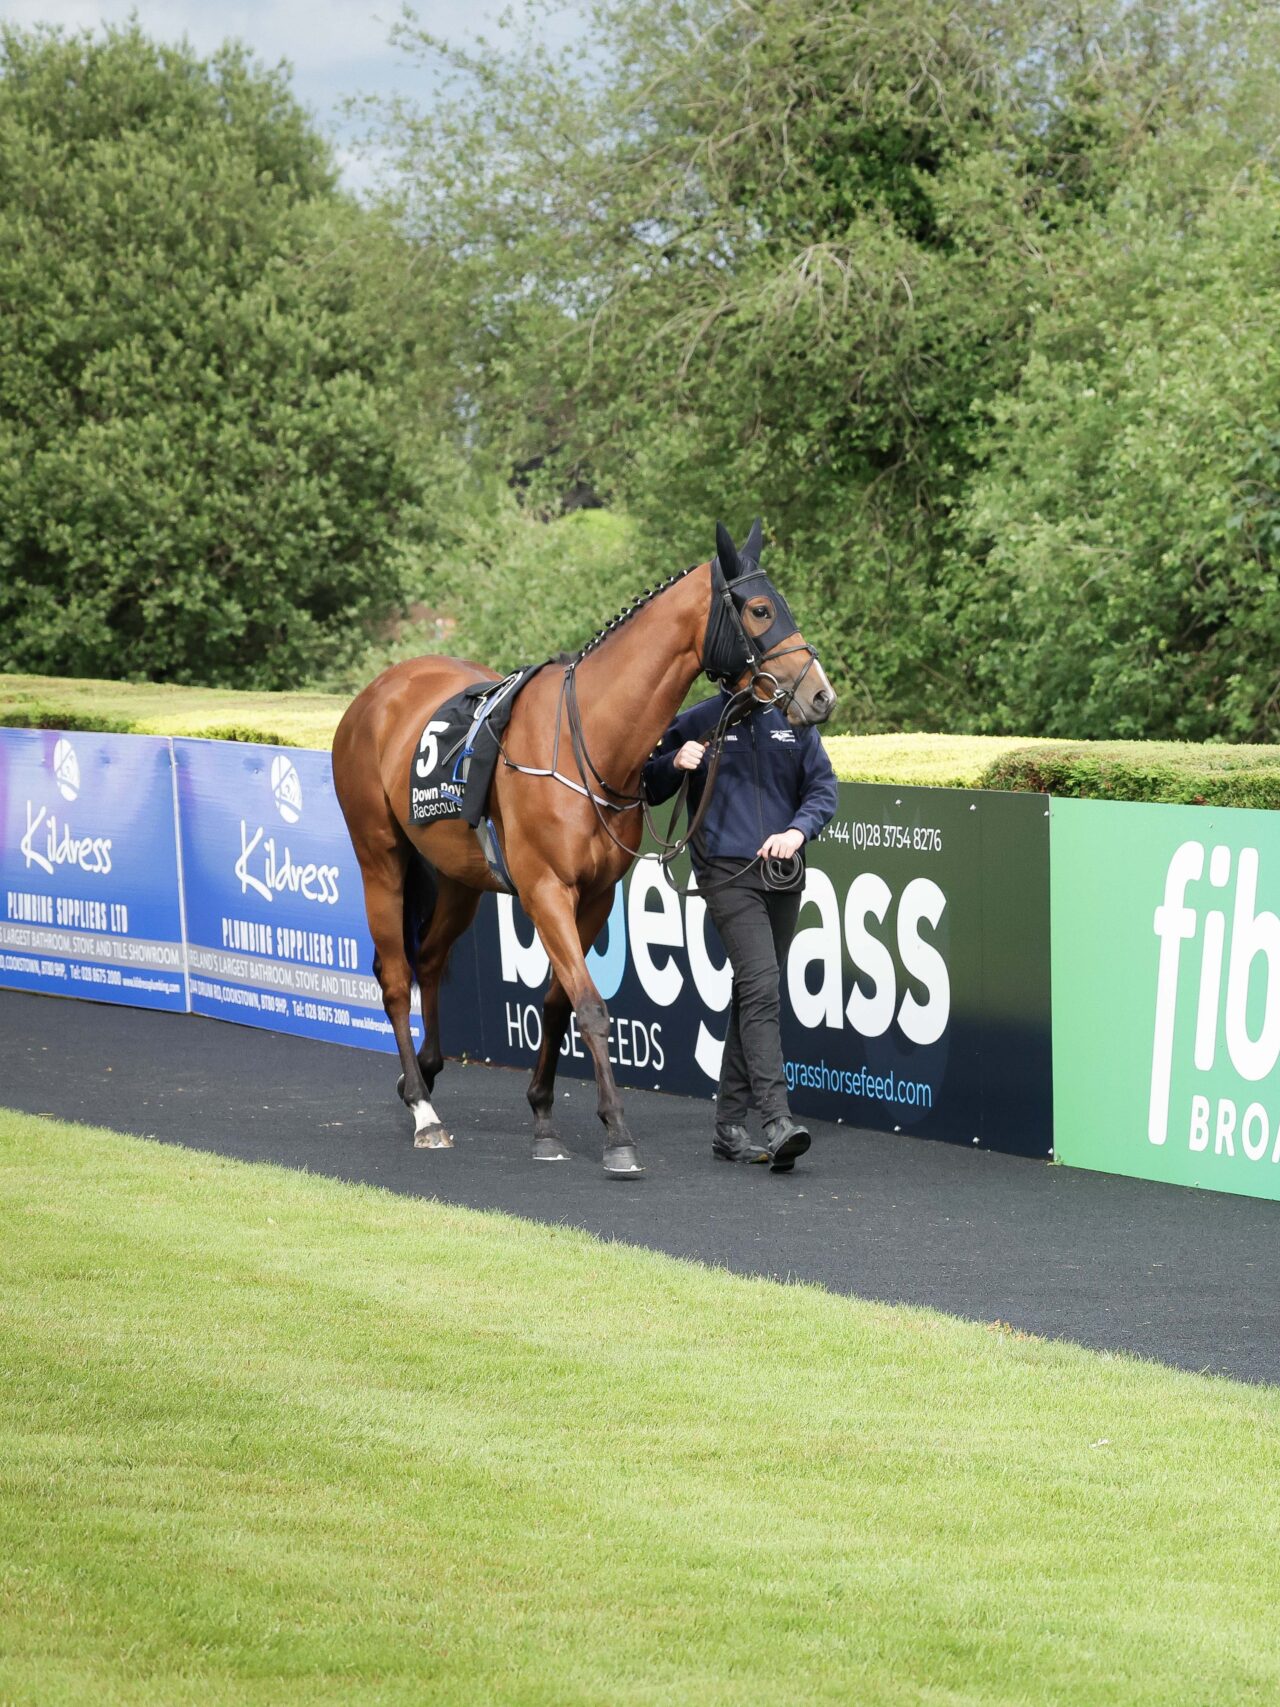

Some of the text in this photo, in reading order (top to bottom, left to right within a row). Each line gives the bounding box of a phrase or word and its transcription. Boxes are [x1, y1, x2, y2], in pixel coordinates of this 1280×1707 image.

[416, 720, 450, 778] 5
[412, 786, 439, 803] Down
[20, 800, 112, 875] Kildress
[828, 821, 850, 844] +44
[852, 821, 881, 851] (0)28
[882, 825, 911, 849] 3754
[913, 827, 942, 852] 8276
[234, 819, 339, 904] Kildress
[8, 891, 129, 933] PLUMBING SUPPLIERS LTD
[3, 927, 31, 946] LARGEST
[73, 936, 95, 955] STOVE
[96, 940, 111, 958] AND
[112, 941, 128, 960] TILE
[128, 943, 179, 966] SHOWROOM
[222, 917, 358, 970] PLUMBING SUPPLIERS LTD
[189, 949, 218, 972] RELAND'S
[219, 955, 248, 978] LARGEST
[249, 962, 295, 990] BATHROOM,
[295, 970, 319, 992] STOVE
[321, 975, 339, 996] AND
[341, 978, 358, 999] TILE
[292, 1001, 304, 1017] Tel:
[305, 1003, 317, 1020] 028
[317, 1005, 333, 1023] 8675
[333, 1008, 350, 1027] 2000
[783, 1059, 932, 1108] grasshorsefeed.com
